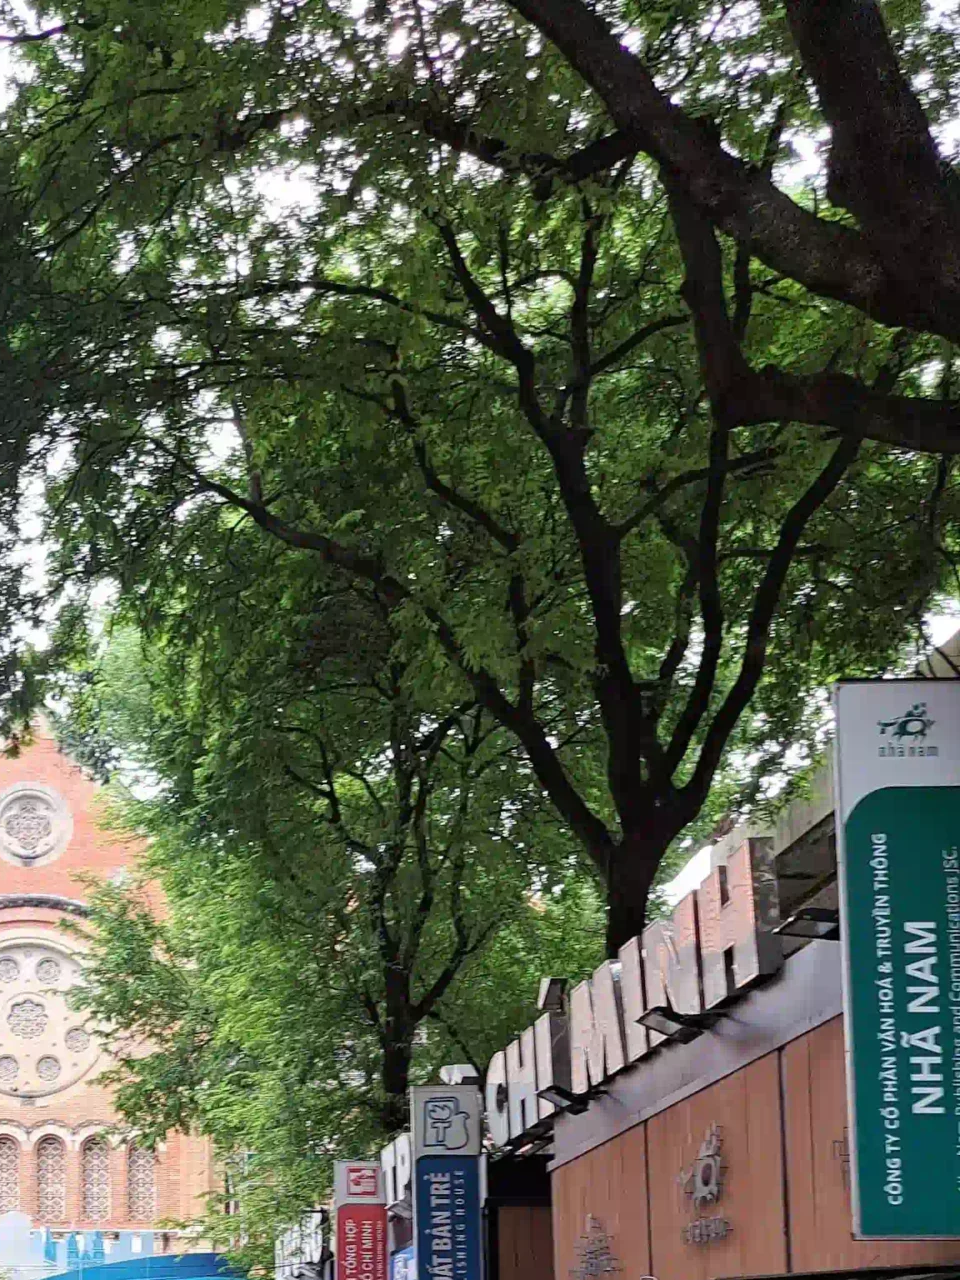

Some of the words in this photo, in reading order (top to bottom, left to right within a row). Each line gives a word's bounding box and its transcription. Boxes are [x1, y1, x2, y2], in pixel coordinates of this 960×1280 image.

[869, 833, 890, 891] THÔNG
[570, 838, 764, 1096] MINH
[878, 961, 893, 973] &
[903, 921, 940, 1013] NAM
[874, 978, 894, 1013] HOÁ
[876, 1018, 896, 1052] VĂN
[878, 1056, 899, 1102] PHẦN
[900, 1026, 945, 1114] NHÃ
[885, 1134, 901, 1153] TY
[423, 1172, 451, 1207] TRẺ
[453, 1170, 466, 1216] HOUSE
[883, 1158, 903, 1205] CÔNG
[361, 1221, 374, 1249] MINH
[424, 1210, 452, 1250] BẢN
